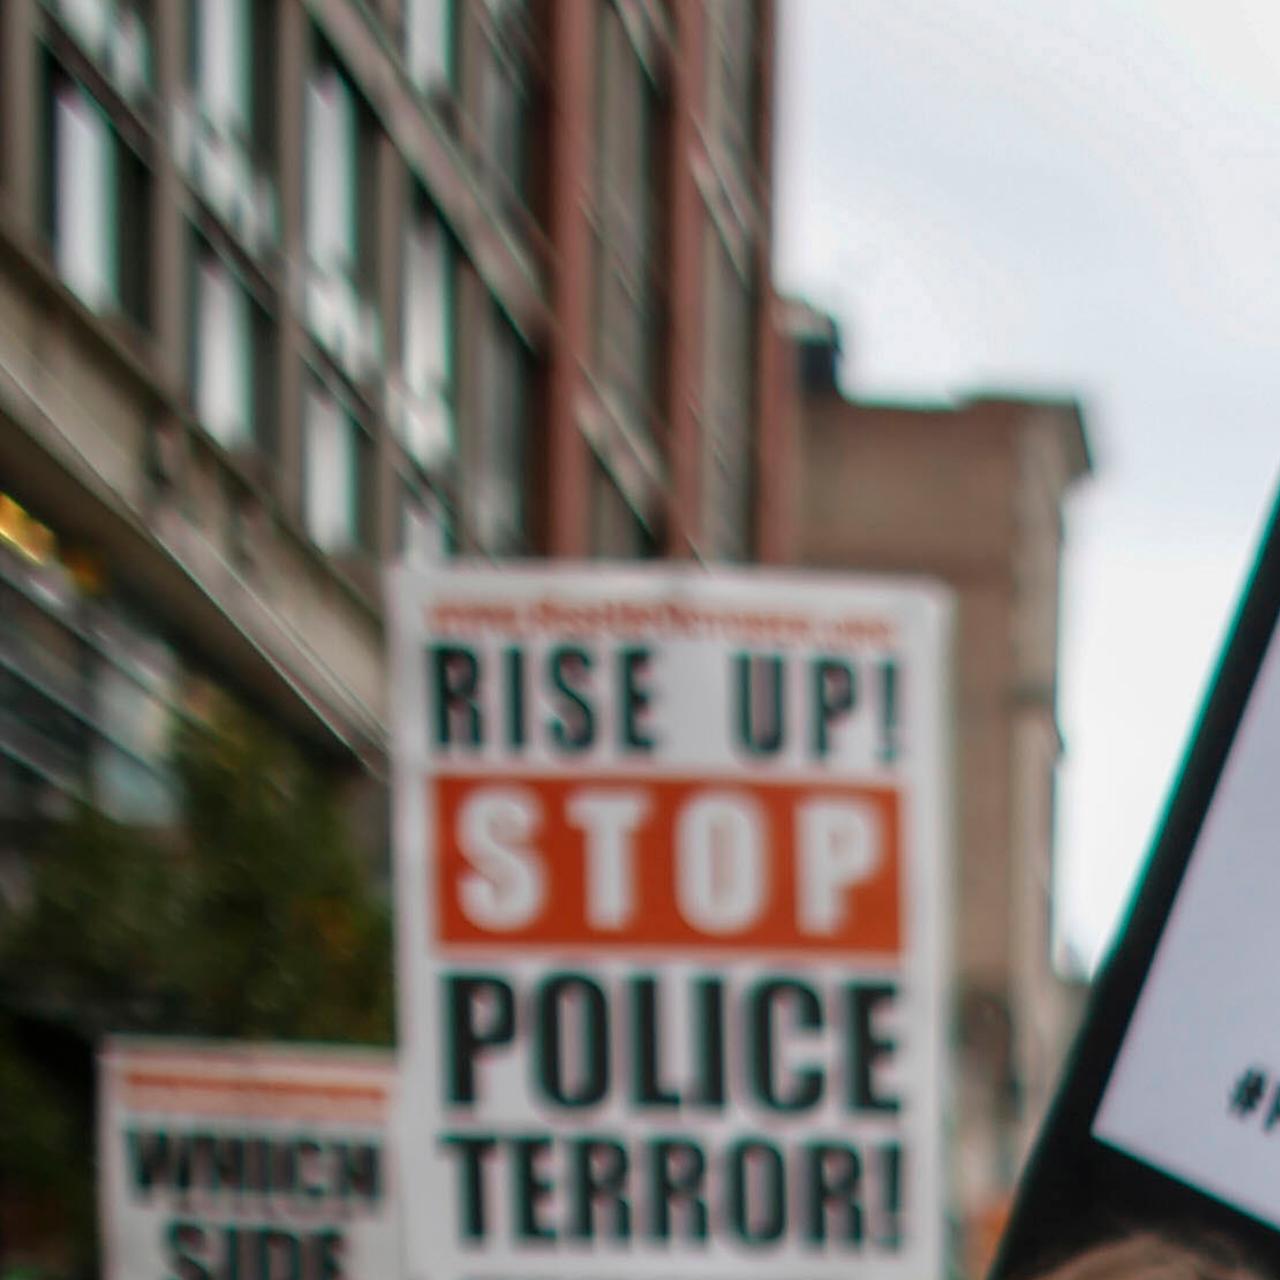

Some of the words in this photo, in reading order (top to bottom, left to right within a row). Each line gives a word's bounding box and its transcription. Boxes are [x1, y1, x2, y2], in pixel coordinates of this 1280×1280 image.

[426, 642, 658, 757] RISE
[732, 652, 903, 764] UP!
[456, 787, 882, 936] STOP
[440, 970, 904, 1115] POLICE
[440, 1132, 904, 1254] TERROR!
